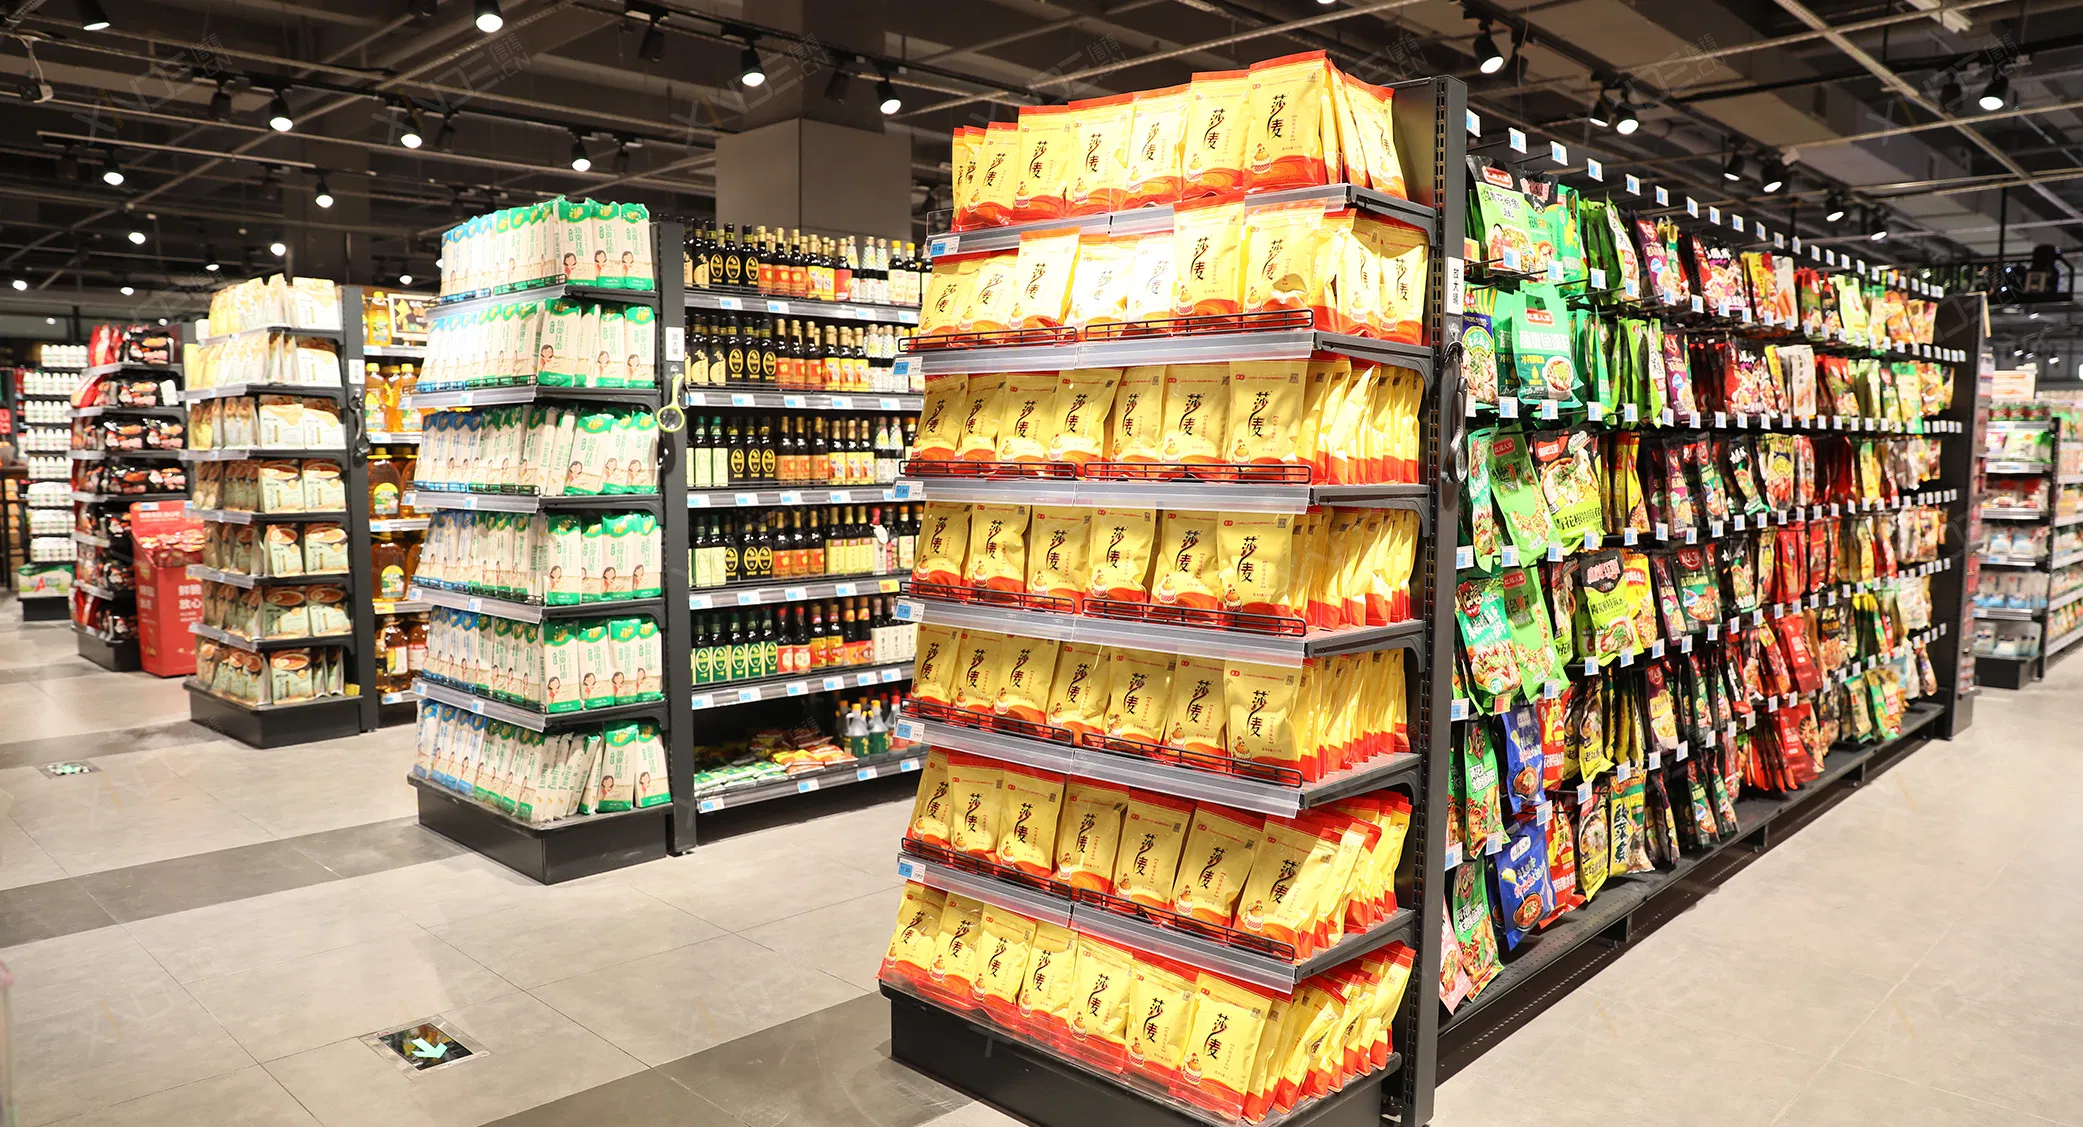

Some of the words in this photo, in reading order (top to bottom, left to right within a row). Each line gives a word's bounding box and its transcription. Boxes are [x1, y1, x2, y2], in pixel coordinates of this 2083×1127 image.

[1203, 108, 1227, 150] 莎麦
[1266, 93, 1289, 140] 莎麦
[983, 153, 1007, 187] 莎麦
[1028, 140, 1049, 180] 莎麦
[1085, 133, 1103, 173] 莎麦
[1190, 236, 1212, 281] 莎麦
[1261, 238, 1285, 281] 莎麦
[1025, 263, 1048, 300] 莎麦
[925, 398, 948, 433] 莎麦
[964, 398, 986, 434] 莎麦
[1014, 399, 1038, 438] 莎麦
[1065, 393, 1090, 433] 莎麦
[1122, 392, 1142, 437] 莎麦
[1178, 393, 1206, 437] 莎麦
[1247, 391, 1273, 438] 莎麦
[930, 516, 951, 555] 莎麦
[986, 519, 1006, 560] 莎麦
[1046, 529, 1070, 571] 莎麦
[1106, 525, 1129, 569] 莎麦
[1175, 529, 1203, 573] 莎麦
[1237, 535, 1261, 583] 莎麦
[920, 642, 940, 681] 莎麦
[965, 648, 988, 689] 莎麦
[1009, 648, 1034, 689] 莎麦
[1065, 663, 1092, 704] 莎麦
[1123, 672, 1150, 716] 莎麦
[1185, 679, 1214, 724] 莎麦
[1246, 689, 1271, 738] 莎麦
[964, 792, 985, 834] 莎麦
[1013, 802, 1036, 845] 莎麦
[1075, 813, 1100, 854] 莎麦
[1133, 832, 1159, 877] 莎麦
[1197, 846, 1229, 890] 莎麦
[900, 910, 927, 945] 莎麦
[948, 919, 974, 958] 莎麦
[987, 937, 1010, 978] 莎麦
[1032, 949, 1055, 992] 莎麦
[1087, 973, 1111, 1017] 莎麦
[1143, 997, 1165, 1044] 莎麦
[1203, 1012, 1230, 1060] 莎麦
